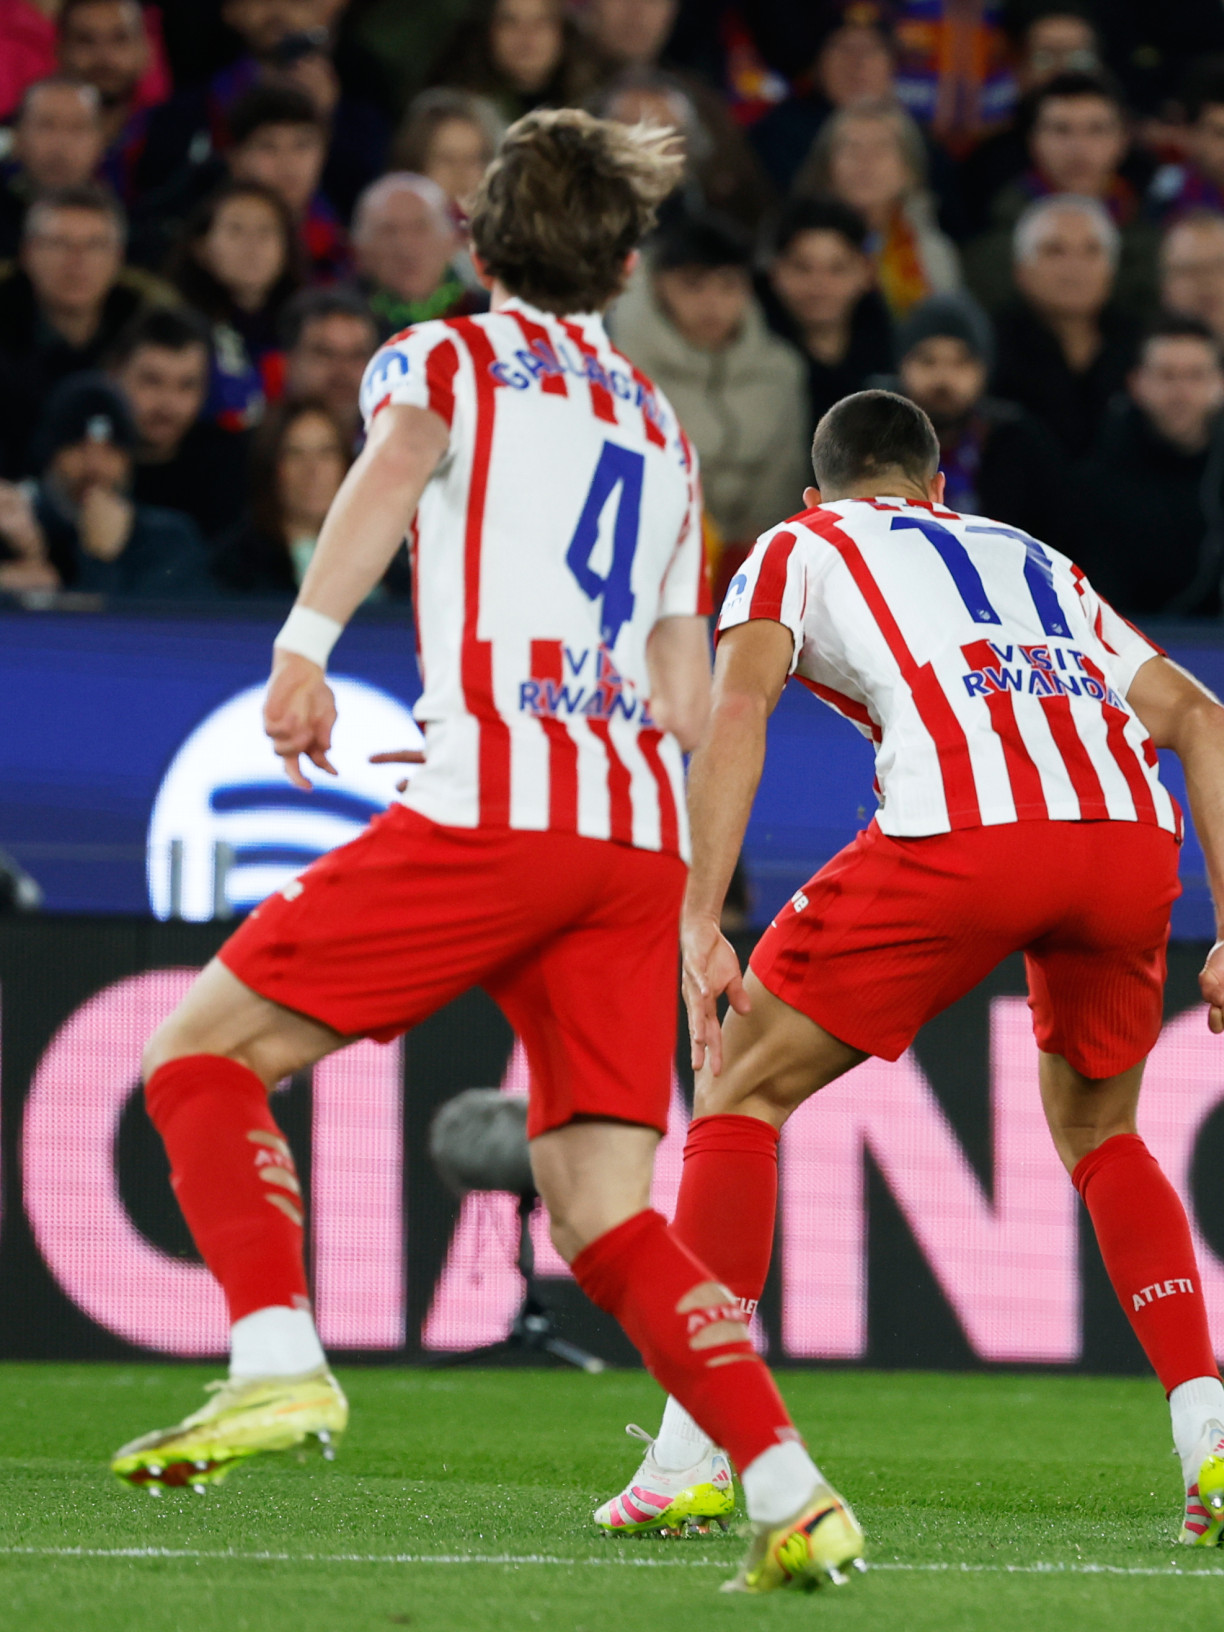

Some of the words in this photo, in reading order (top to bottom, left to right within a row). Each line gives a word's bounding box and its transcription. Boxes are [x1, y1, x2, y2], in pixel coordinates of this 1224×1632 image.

[564, 438, 646, 652] 4
[890, 516, 1074, 640] 17
[988, 642, 1084, 671] VISIT
[962, 666, 1127, 712] RWANDA
[1132, 1278, 1194, 1312] ATLETI
